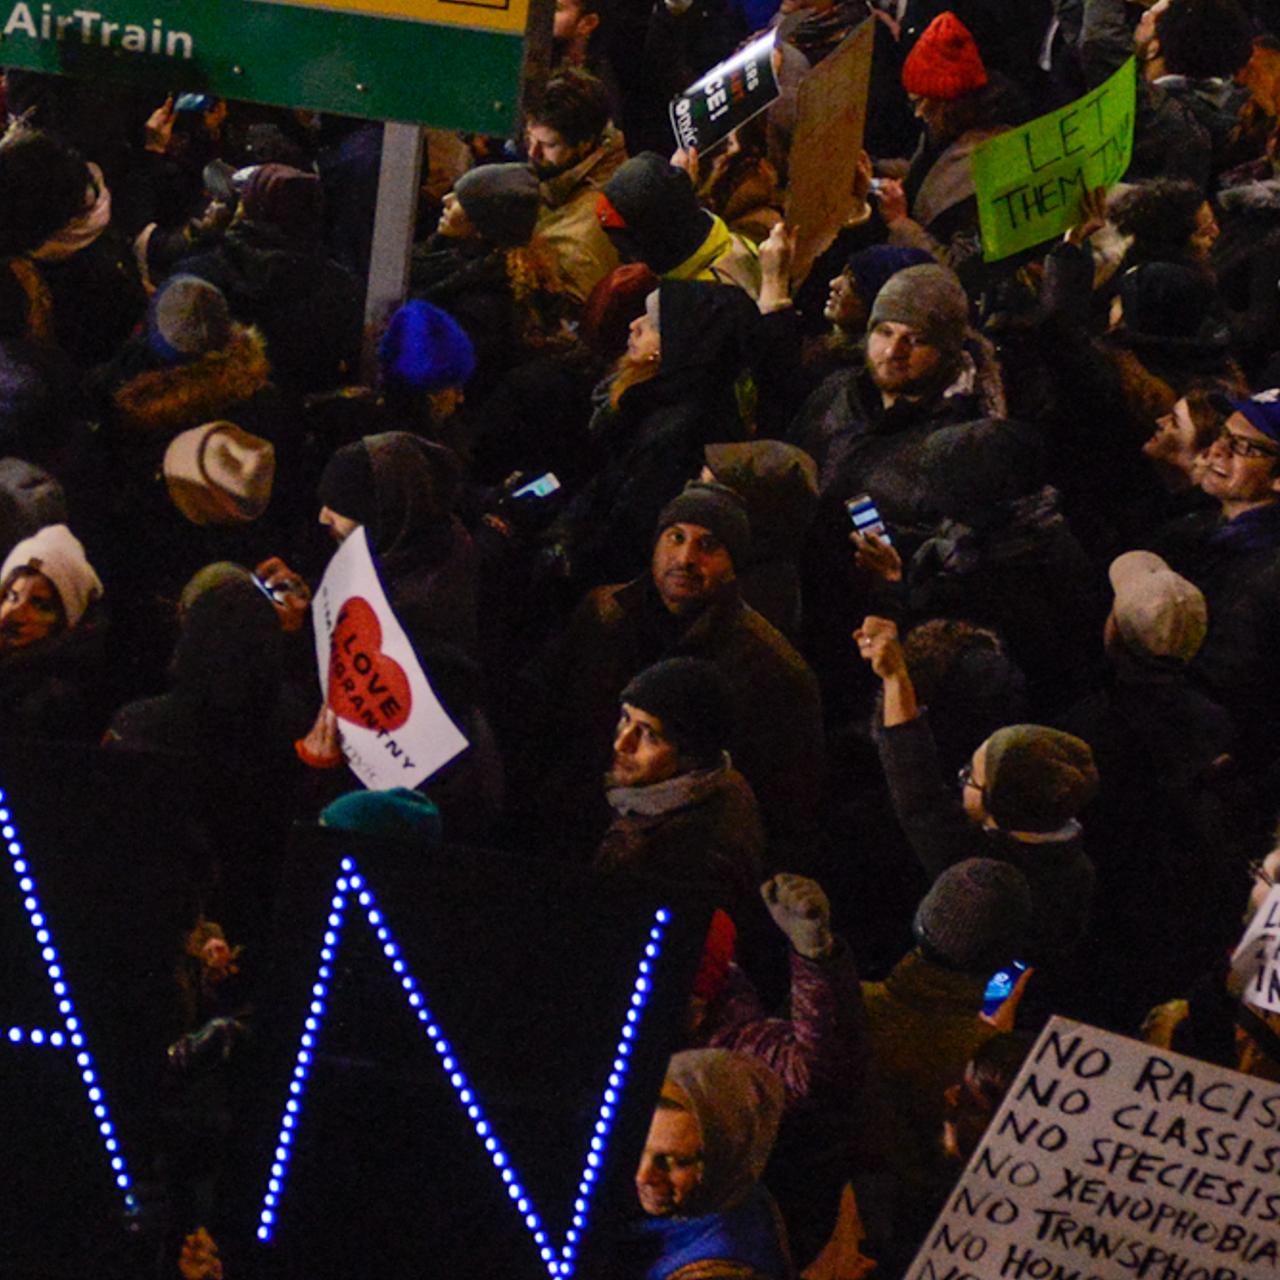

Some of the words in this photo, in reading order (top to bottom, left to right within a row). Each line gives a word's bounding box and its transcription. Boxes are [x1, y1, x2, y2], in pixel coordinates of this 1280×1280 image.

[3, 0, 194, 59] AirTrain
[1023, 89, 1111, 174] LET
[992, 167, 1089, 229] THEM
[343, 631, 403, 719] LOVE
[1035, 1030, 1112, 1081] NO
[1016, 1073, 1090, 1116] NO
[996, 1110, 1068, 1154] NO
[951, 1185, 1020, 1228] NO
[972, 1146, 1041, 1188] NO
[1051, 1168, 1280, 1270] XENOPHOBIA
[931, 1223, 988, 1264] NO
